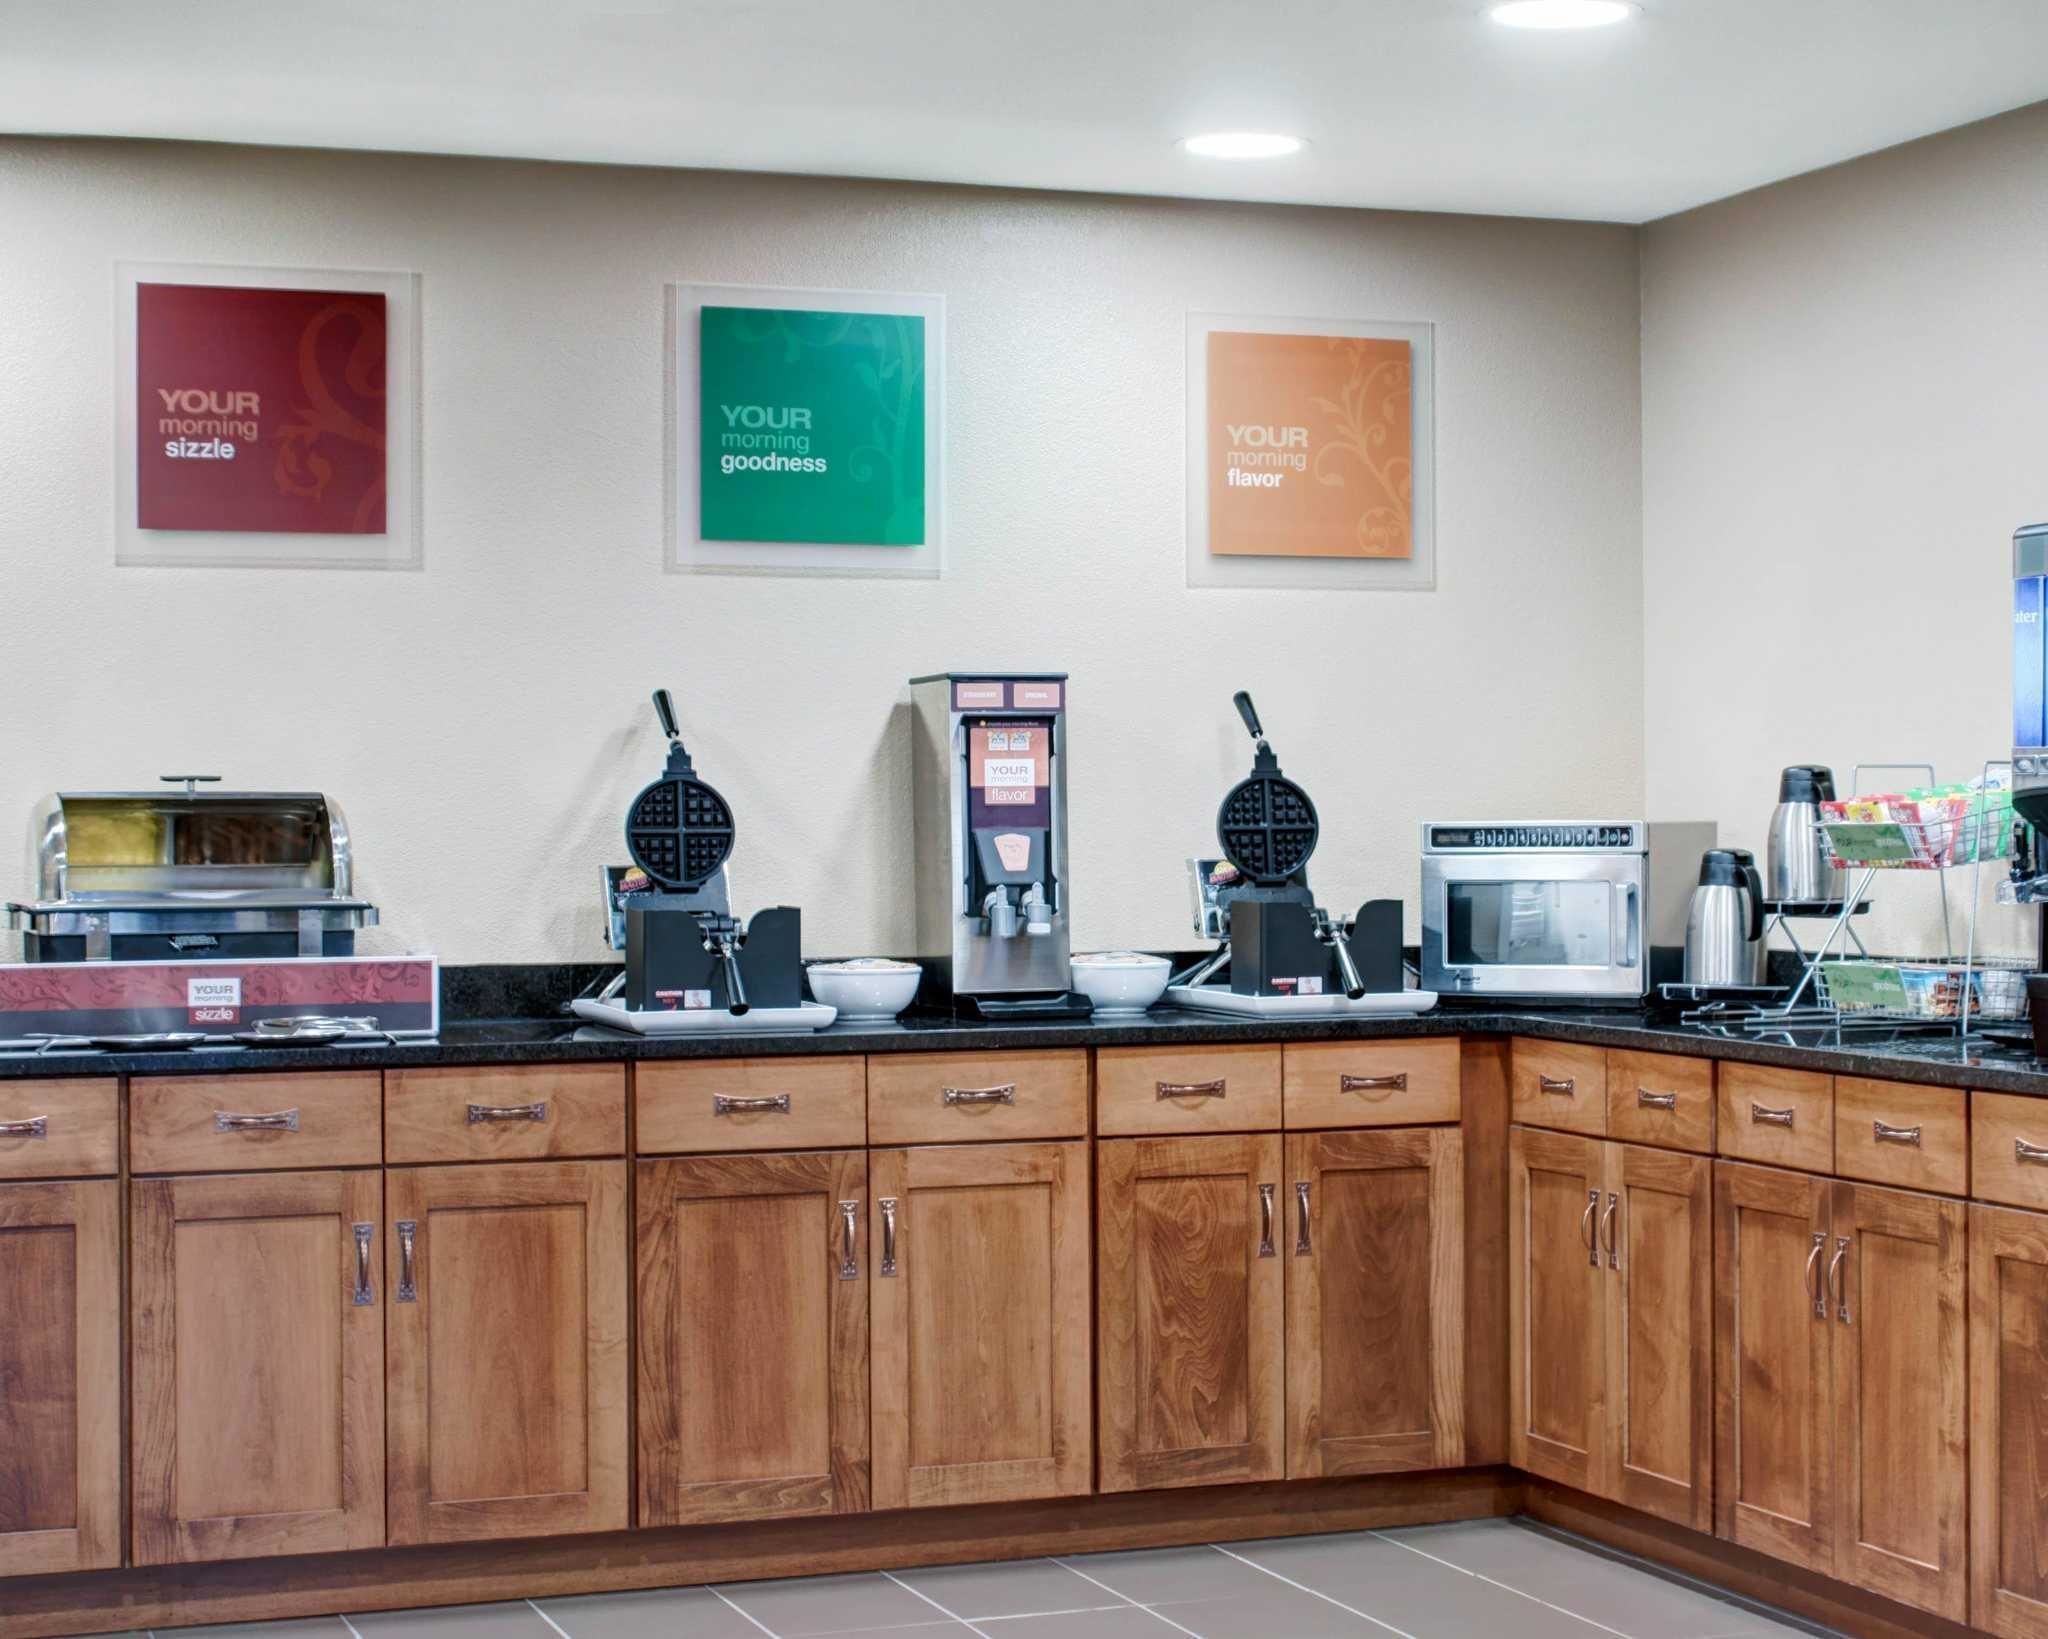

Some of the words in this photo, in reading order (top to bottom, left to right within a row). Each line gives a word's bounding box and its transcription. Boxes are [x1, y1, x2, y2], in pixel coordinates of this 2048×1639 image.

[158, 389, 260, 414] YOUR
[721, 405, 812, 430] YOUR
[159, 416, 259, 442] morning
[1226, 424, 1309, 448] YOUR
[164, 437, 235, 459] sizzle
[721, 431, 810, 455] morning
[720, 452, 828, 474] goodness
[1227, 450, 1307, 472] morning
[1227, 468, 1283, 488] flavor
[991, 766, 1029, 775] YOUR
[992, 787, 1027, 801] flavor
[193, 985, 233, 995] YOUR
[193, 995, 233, 1003] morning
[194, 1007, 234, 1021] sizzle
